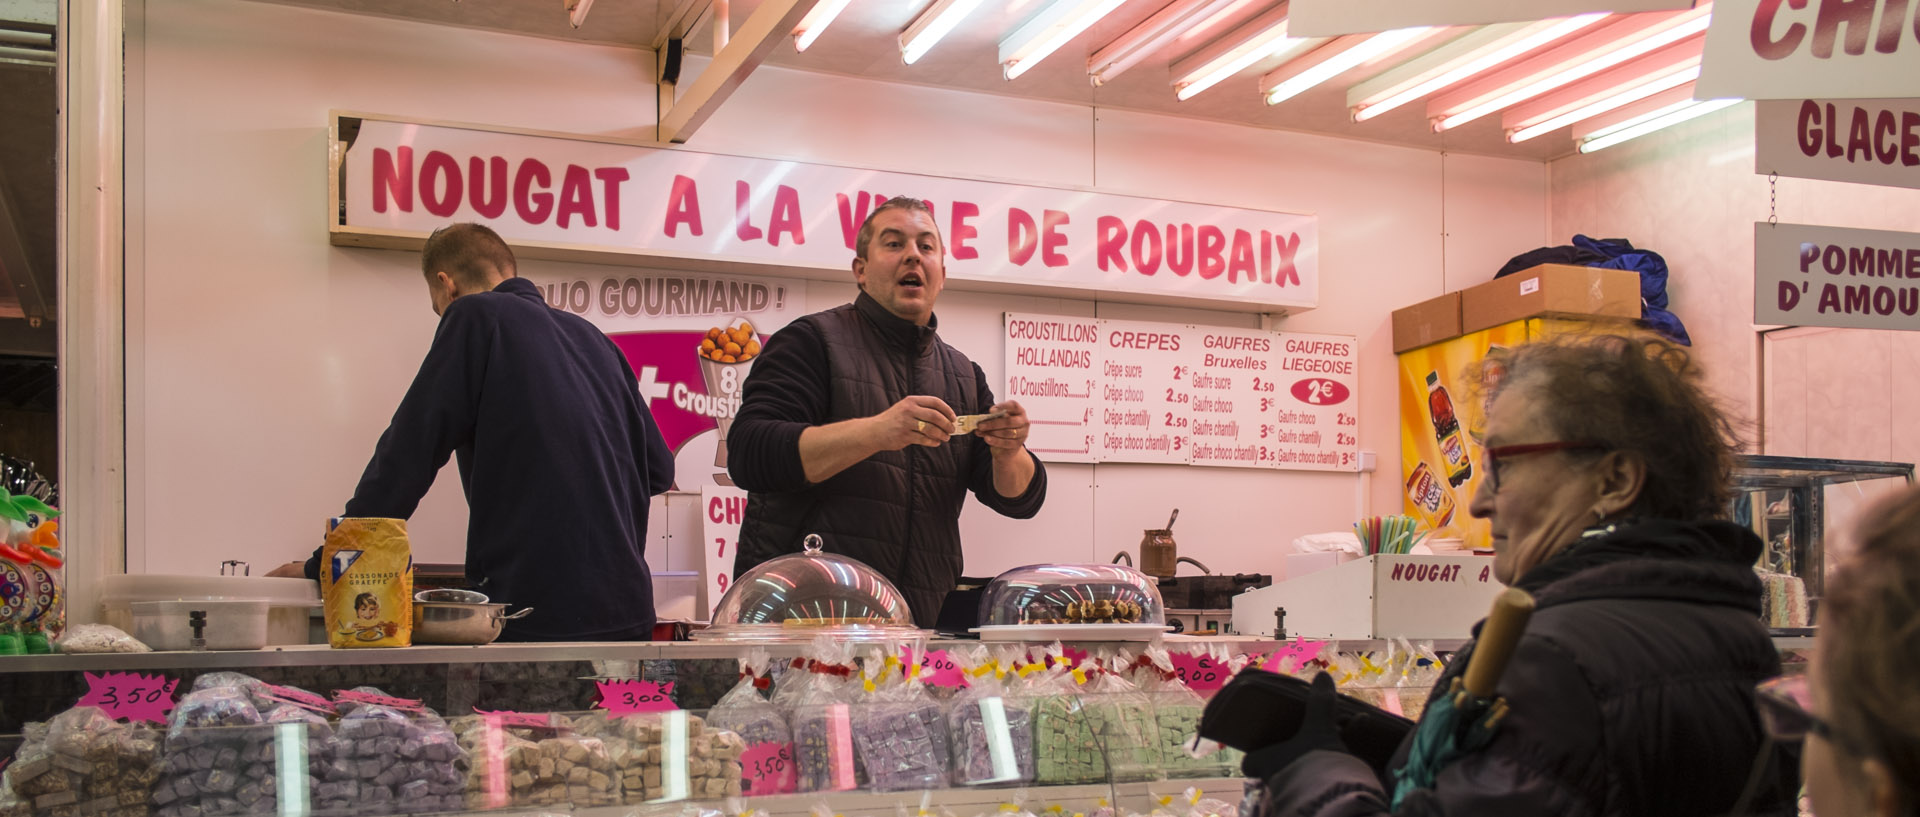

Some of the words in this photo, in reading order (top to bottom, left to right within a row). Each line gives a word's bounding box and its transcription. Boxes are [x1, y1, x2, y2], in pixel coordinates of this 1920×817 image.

[1751, 0, 1920, 60] CHI
[1797, 99, 1920, 167] GLACE
[373, 146, 629, 231] NOUGAT
[664, 175, 703, 238] A
[736, 180, 805, 247] LA
[1007, 207, 1069, 268] DE
[1097, 215, 1300, 288] ROUBAIX
[1800, 242, 1920, 279] POMME
[599, 277, 769, 316] GOURMAND
[1009, 320, 1098, 343] CROUSTILLONS
[1109, 331, 1181, 351] CREPES
[1203, 334, 1270, 352] GAUFRES
[1285, 339, 1350, 357] GAUFRES
[1016, 347, 1091, 369] HOLLANDAIS
[1204, 353, 1267, 370] Bruxelles
[1282, 357, 1353, 375] LIEGEOISE
[720, 366, 738, 394] 8
[1125, 365, 1142, 378] sucre
[1192, 371, 1213, 389] Gaufre
[1214, 376, 1231, 390] sucre
[1253, 377, 1275, 392] 2.50
[1009, 376, 1018, 395] 10
[1124, 385, 1144, 402] choco
[1166, 388, 1189, 404] 2.50
[1308, 379, 1334, 403] 2€
[673, 383, 744, 419] Crousti
[1192, 395, 1213, 412] Gaufre
[1214, 396, 1233, 413] choco
[1124, 409, 1151, 431] chantilly
[1165, 412, 1187, 428] 2.50
[1278, 409, 1297, 424] Gaufre
[1298, 410, 1316, 425] choco
[1192, 418, 1213, 436] Gaufre
[1214, 419, 1239, 441] chantilly
[1278, 428, 1297, 443] Gaufre
[1298, 430, 1322, 448] chantilly
[1124, 433, 1144, 450] choco
[1145, 433, 1171, 455] chantilly
[1192, 442, 1213, 459] Gaufre
[1214, 443, 1233, 460] choco
[1234, 444, 1259, 465] chantilly
[1278, 448, 1297, 463] Gaufre
[1298, 449, 1316, 464] choco
[1317, 450, 1340, 468] chantilly
[1414, 474, 1430, 503] Lipton
[717, 572, 728, 594] 9
[1391, 562, 1461, 582] NOUGAT
[1478, 564, 1490, 583] A
[98, 681, 173, 709] 3,50€
